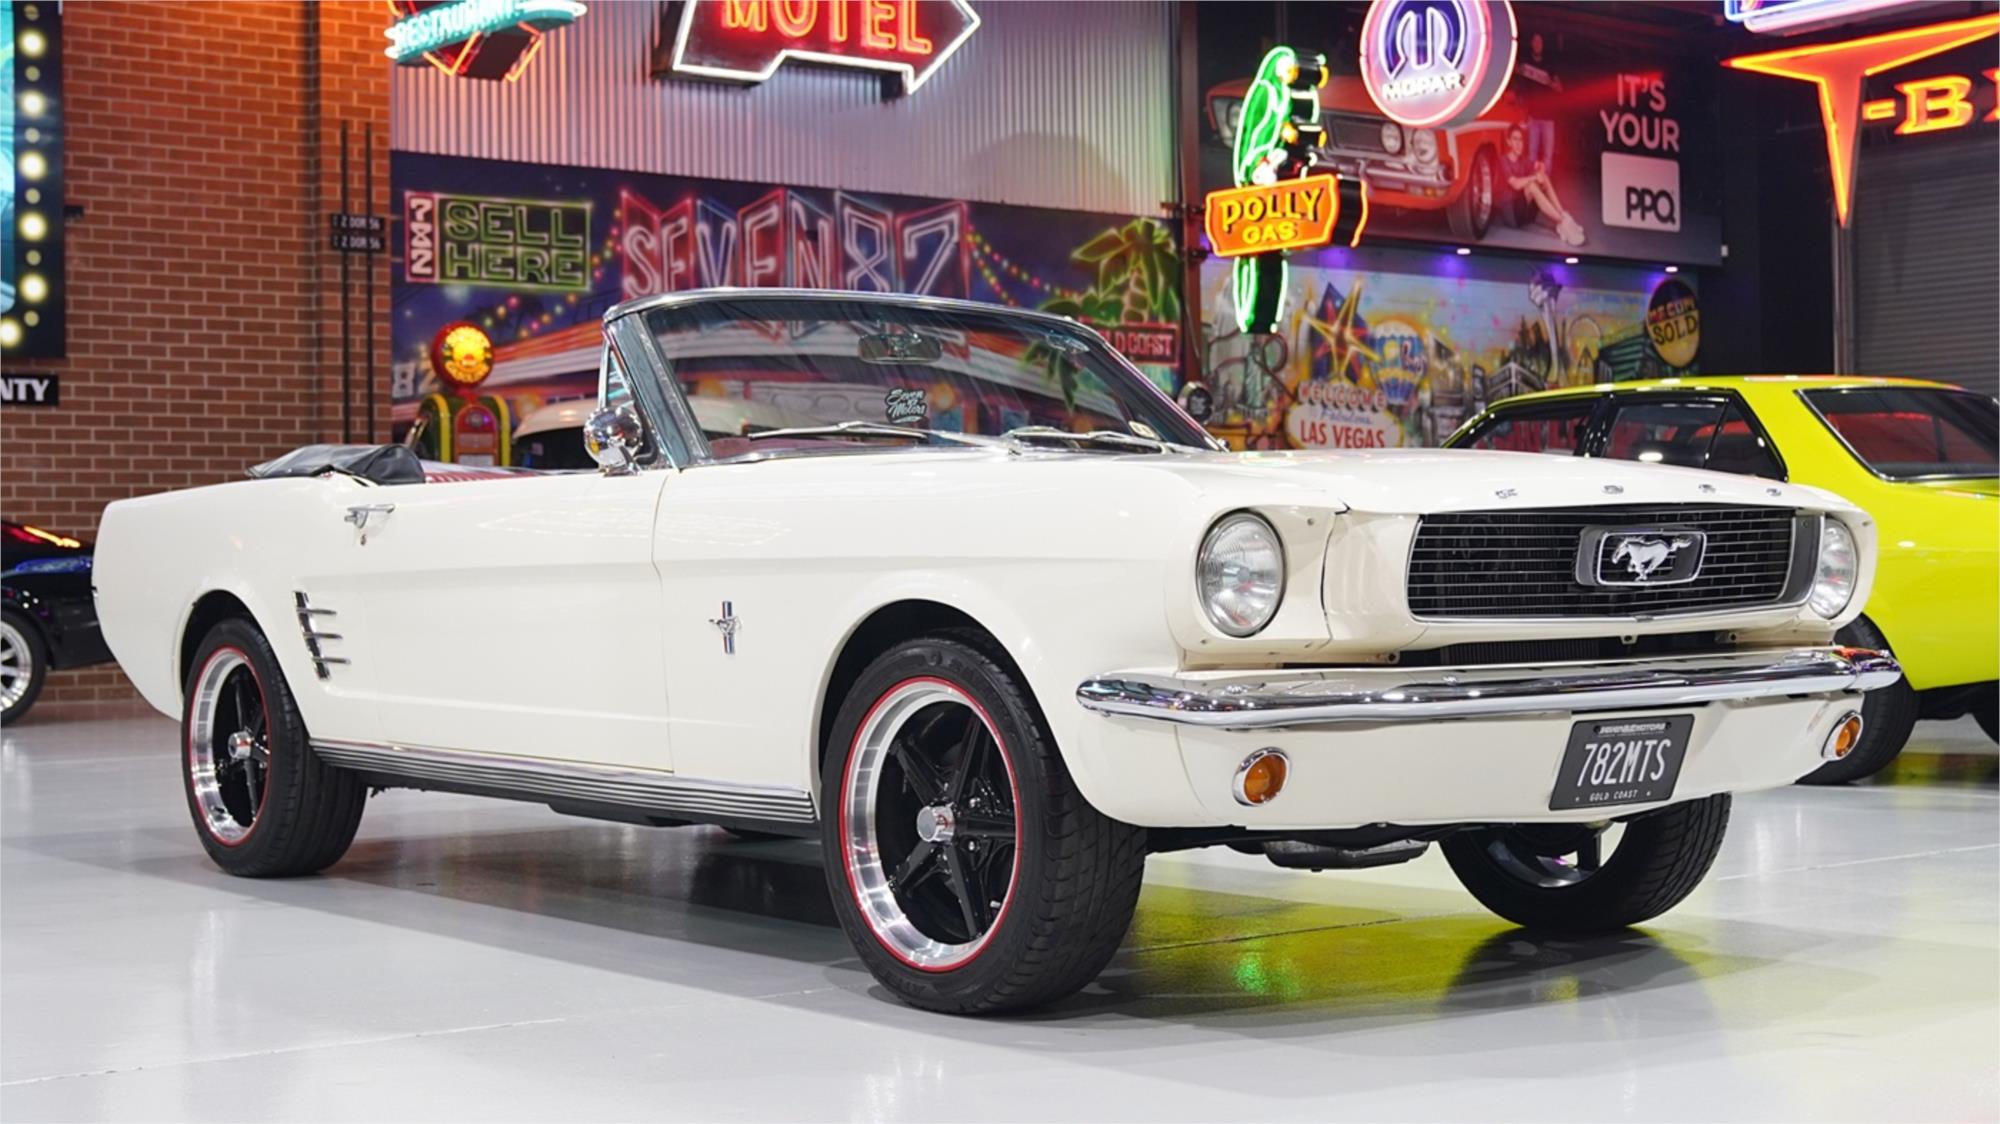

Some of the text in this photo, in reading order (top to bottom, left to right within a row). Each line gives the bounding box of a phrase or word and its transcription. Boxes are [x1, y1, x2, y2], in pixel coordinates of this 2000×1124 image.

[1382, 74, 1465, 101] MOPAR
[1617, 74, 1666, 112] IT'S
[1600, 109, 1680, 152] YOUR
[1219, 187, 1324, 234] POLLY
[1626, 185, 1676, 225] PPQ
[445, 201, 584, 248] SELL
[1242, 221, 1298, 244] GAS
[445, 242, 584, 284] HERE
[1127, 332, 1173, 356] COAST
[1652, 314, 1697, 346] SOLD
[1, 378, 49, 401] NTY
[1300, 419, 1386, 449] LAS VEGAS
[1577, 739, 1671, 787] 782MTS
[1589, 789, 1638, 801] GOLD COAST
